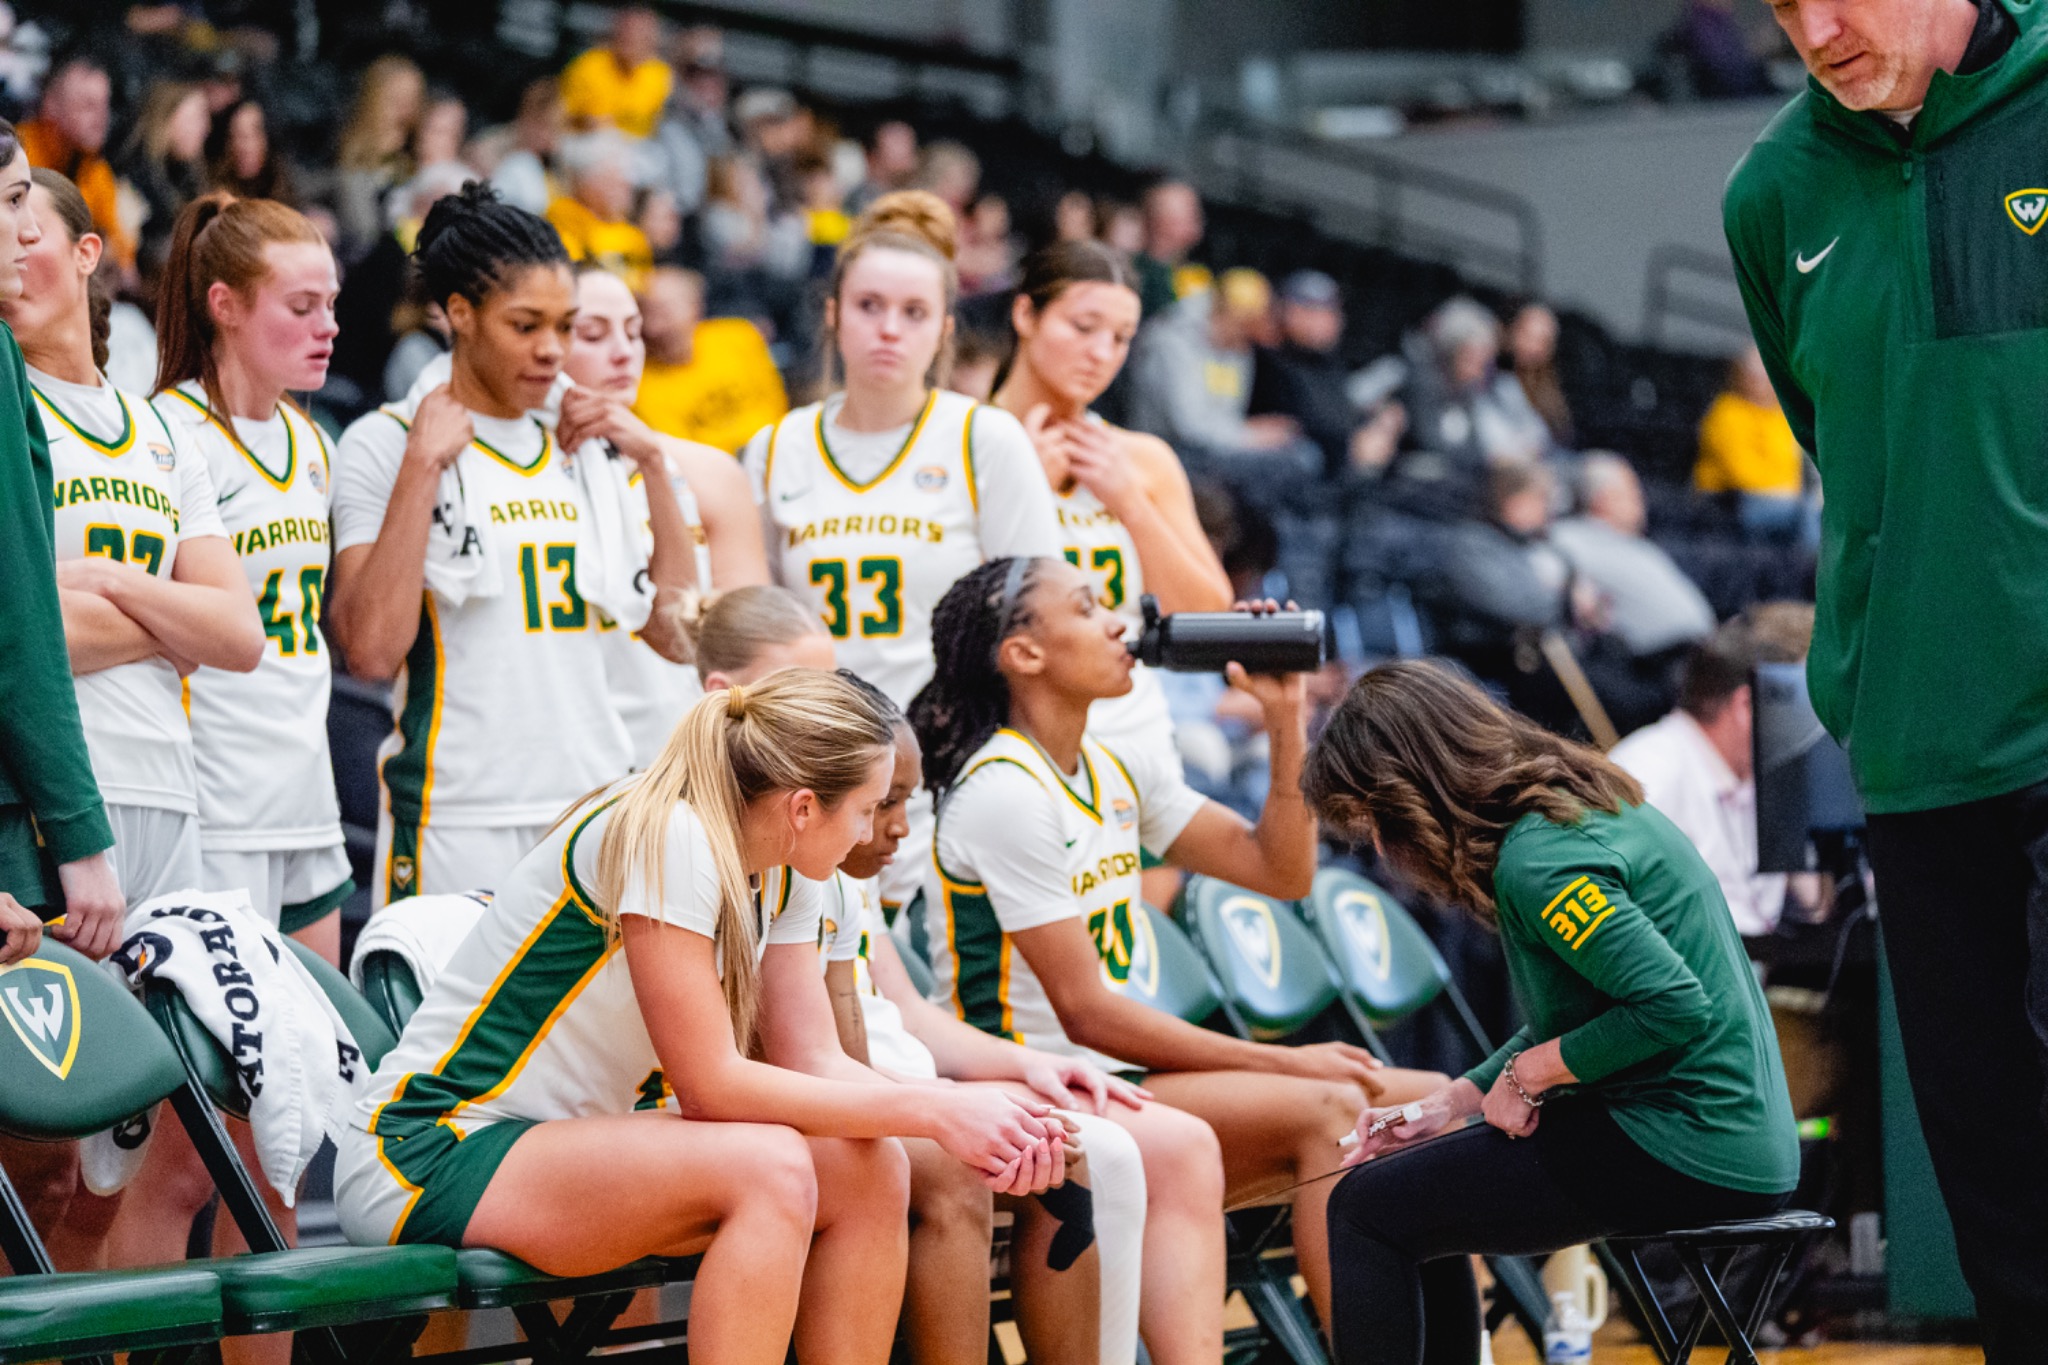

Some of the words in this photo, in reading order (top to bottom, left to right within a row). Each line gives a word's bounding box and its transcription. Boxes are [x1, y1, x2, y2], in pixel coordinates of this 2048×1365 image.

[490, 499, 578, 527] ARRIO
[258, 565, 325, 657] 40
[517, 541, 588, 632] 13
[808, 555, 904, 641] 33
[1063, 546, 1125, 611] 3
[1550, 883, 1608, 941] 313
[4, 983, 64, 1042] W
